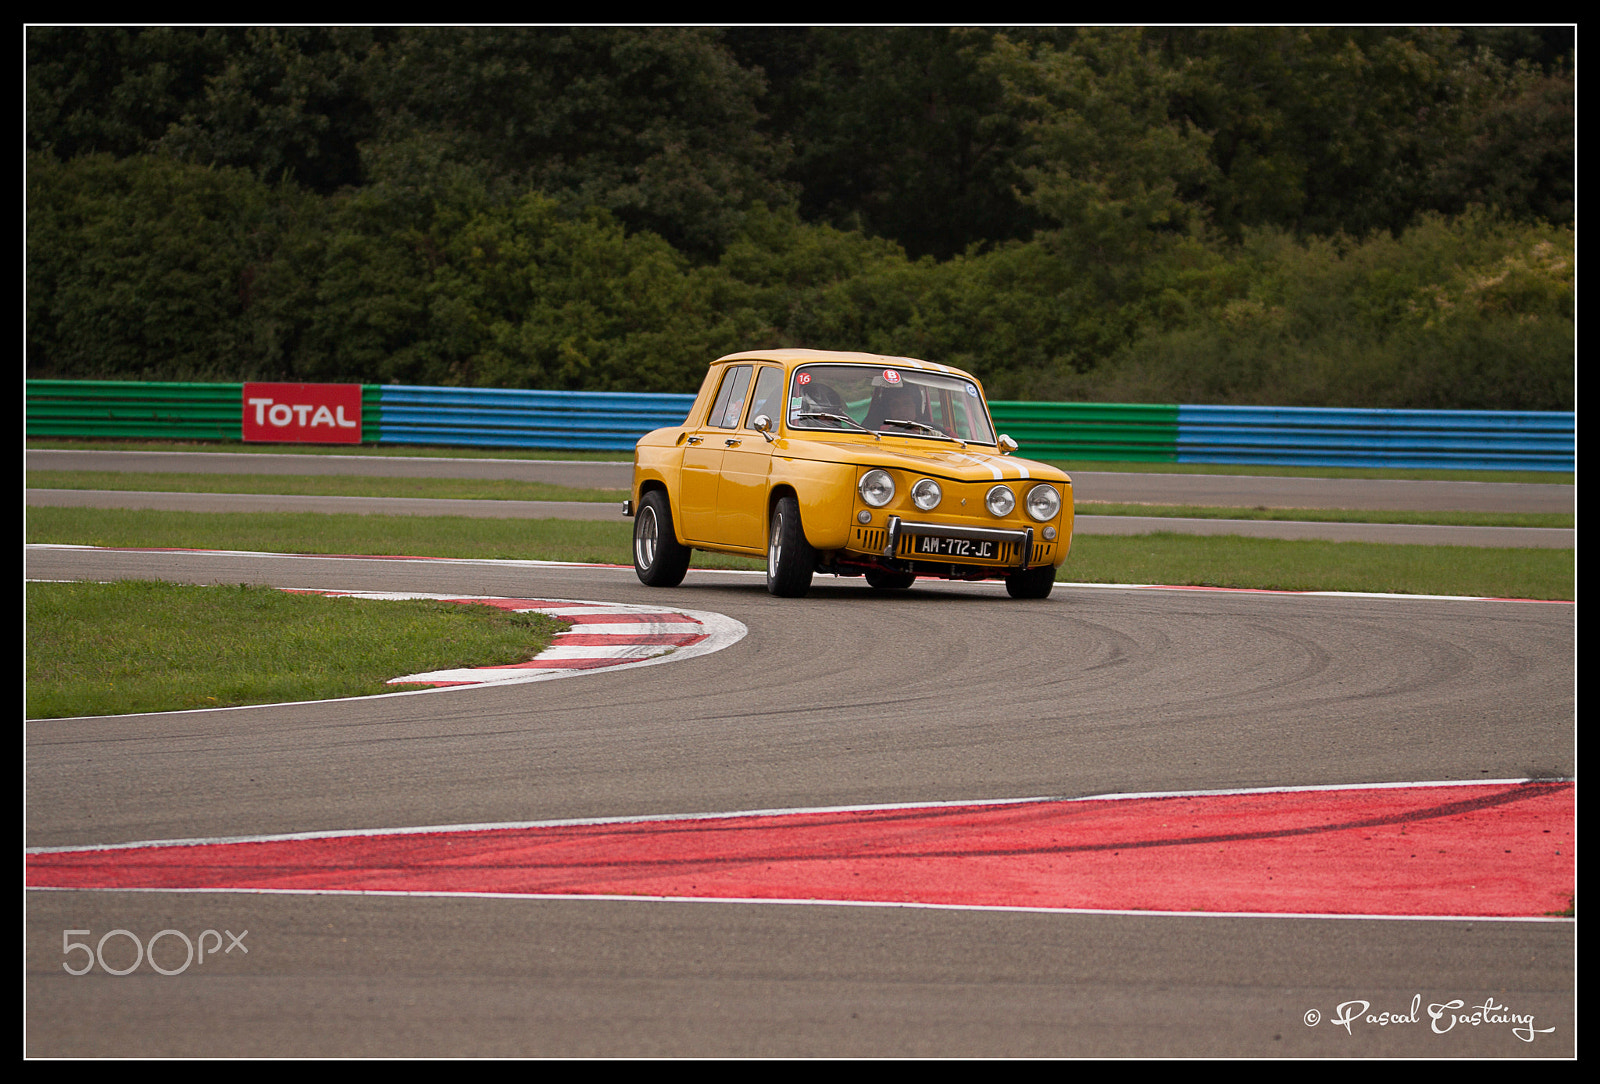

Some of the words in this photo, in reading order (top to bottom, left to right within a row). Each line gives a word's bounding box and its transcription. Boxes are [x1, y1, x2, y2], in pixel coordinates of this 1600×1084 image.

[799, 374, 810, 383] 16
[887, 370, 897, 379] B
[249, 397, 357, 427] TOTAL
[921, 536, 993, 557] AM-772-JC
